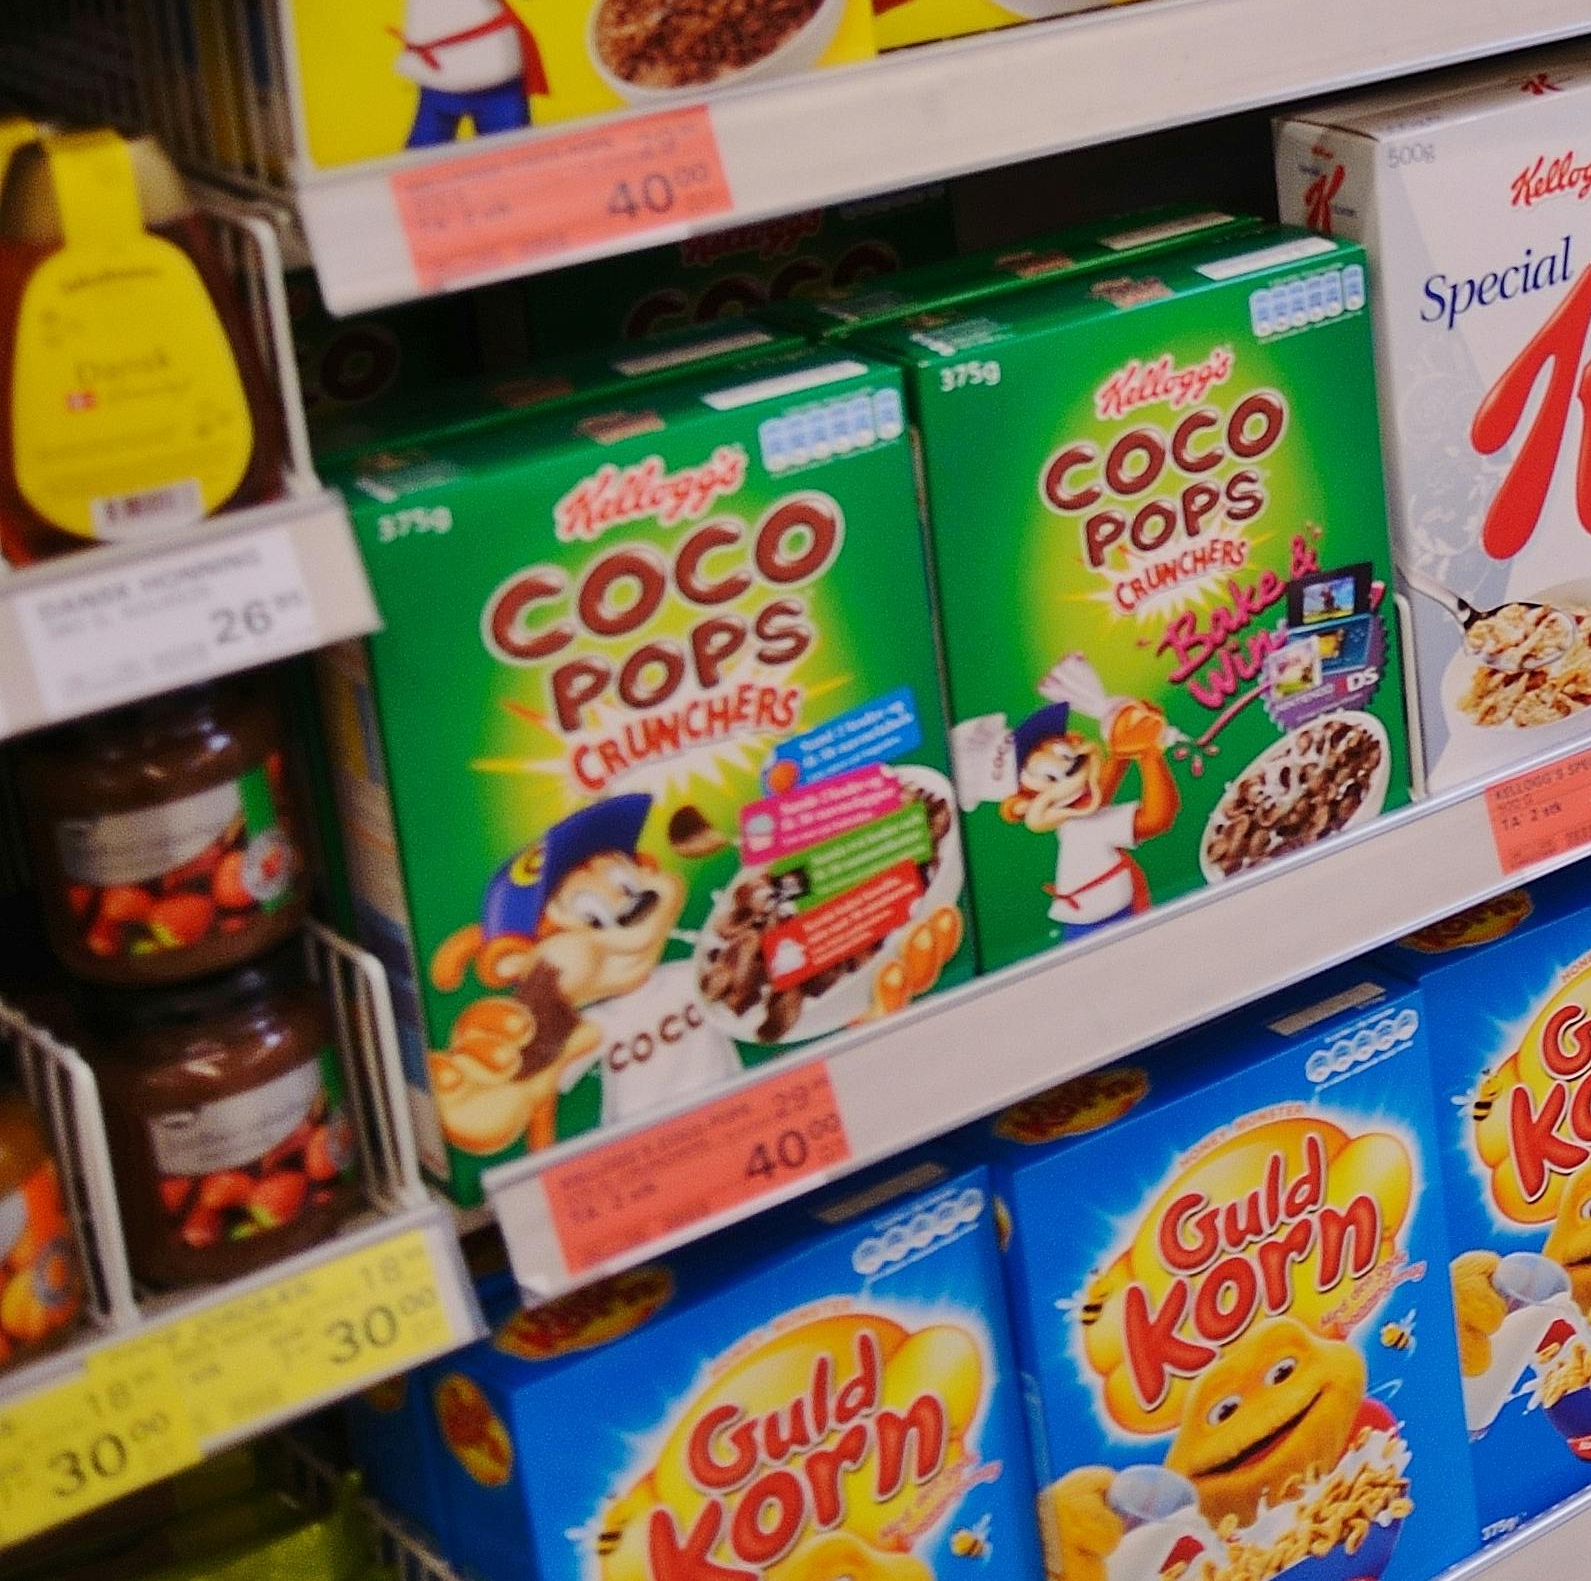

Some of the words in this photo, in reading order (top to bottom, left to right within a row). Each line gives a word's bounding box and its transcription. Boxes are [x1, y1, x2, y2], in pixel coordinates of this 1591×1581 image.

[1418, 235, 1574, 327] Special
[1042, 390, 1287, 513] COCO
[485, 494, 845, 665] COCO
[1080, 467, 1268, 573] POPS
[1115, 537, 1250, 616] CRUNCHERS
[548, 603, 813, 733] POPS
[566, 683, 800, 791] CRUNCHERS
[1161, 1137, 1330, 1277] Guld
[688, 1330, 880, 1487] Guld
